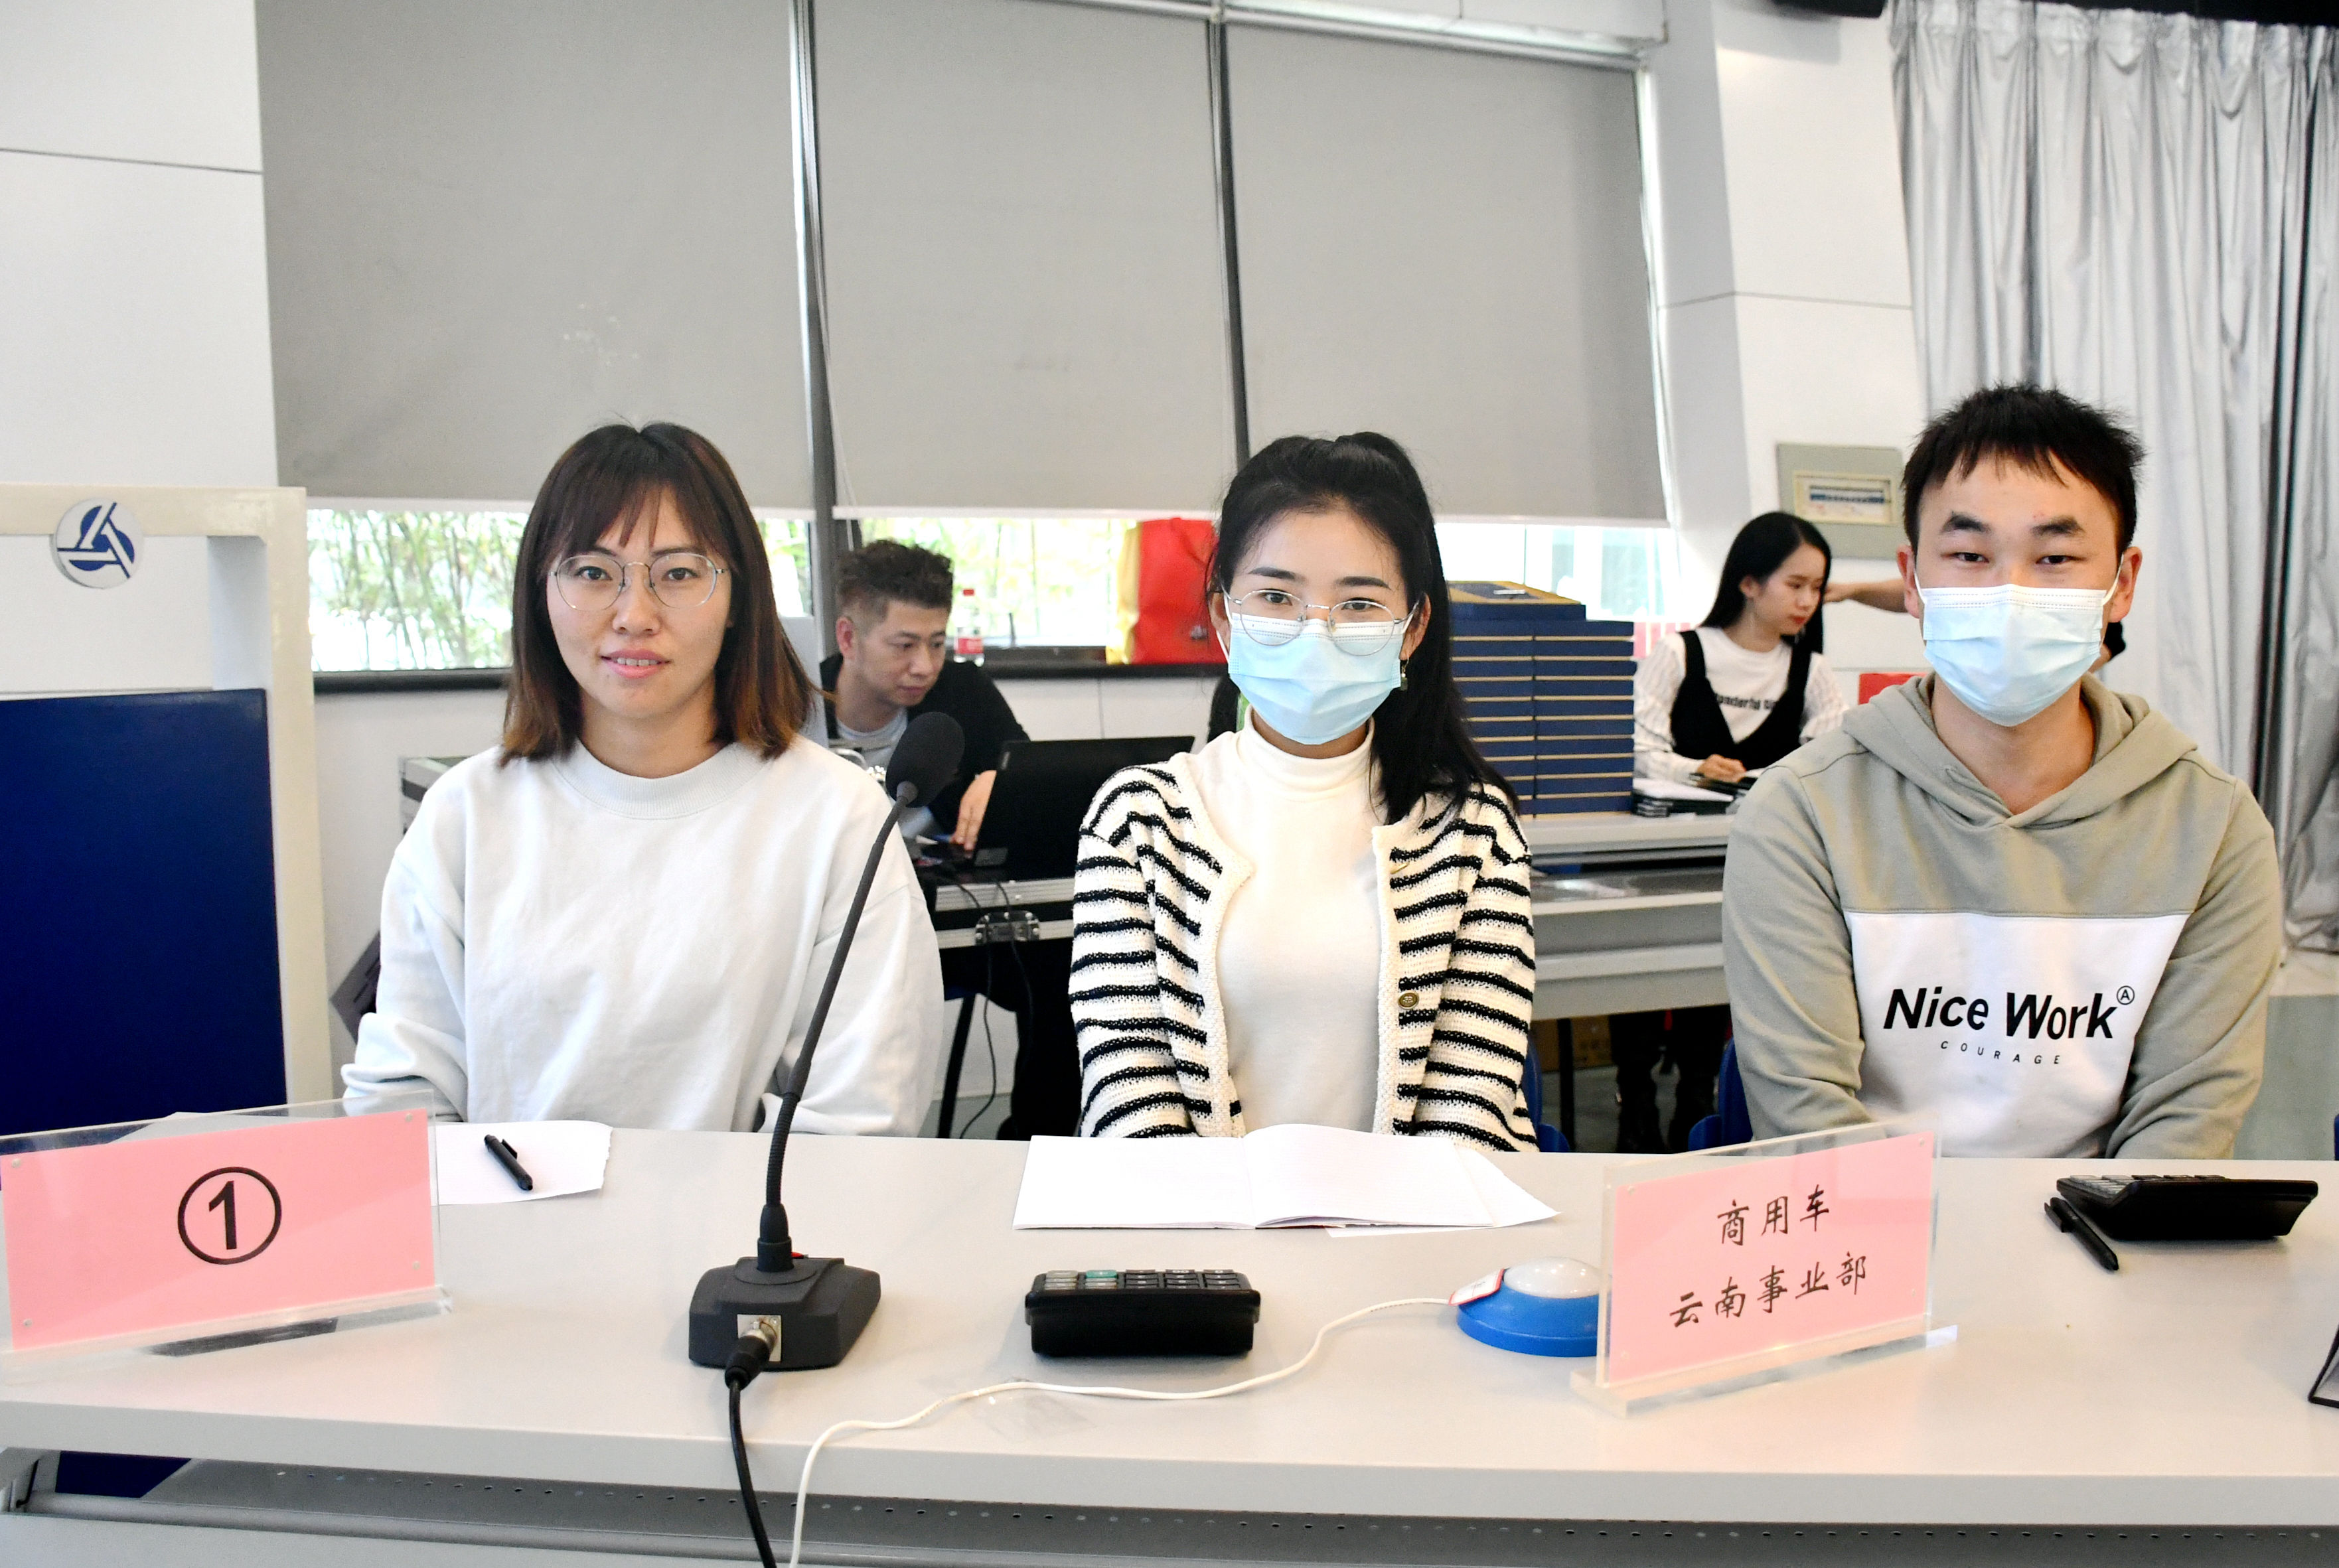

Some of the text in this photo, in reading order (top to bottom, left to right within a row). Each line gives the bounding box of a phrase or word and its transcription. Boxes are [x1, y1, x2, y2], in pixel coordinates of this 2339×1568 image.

[1883, 985, 1989, 1031] Nice
[2006, 992, 2117, 1040] Work
[1940, 1040, 2061, 1065] COURAGE
[1716, 1183, 1830, 1246] 商用车
[1669, 1251, 1867, 1328] 云南事业部
